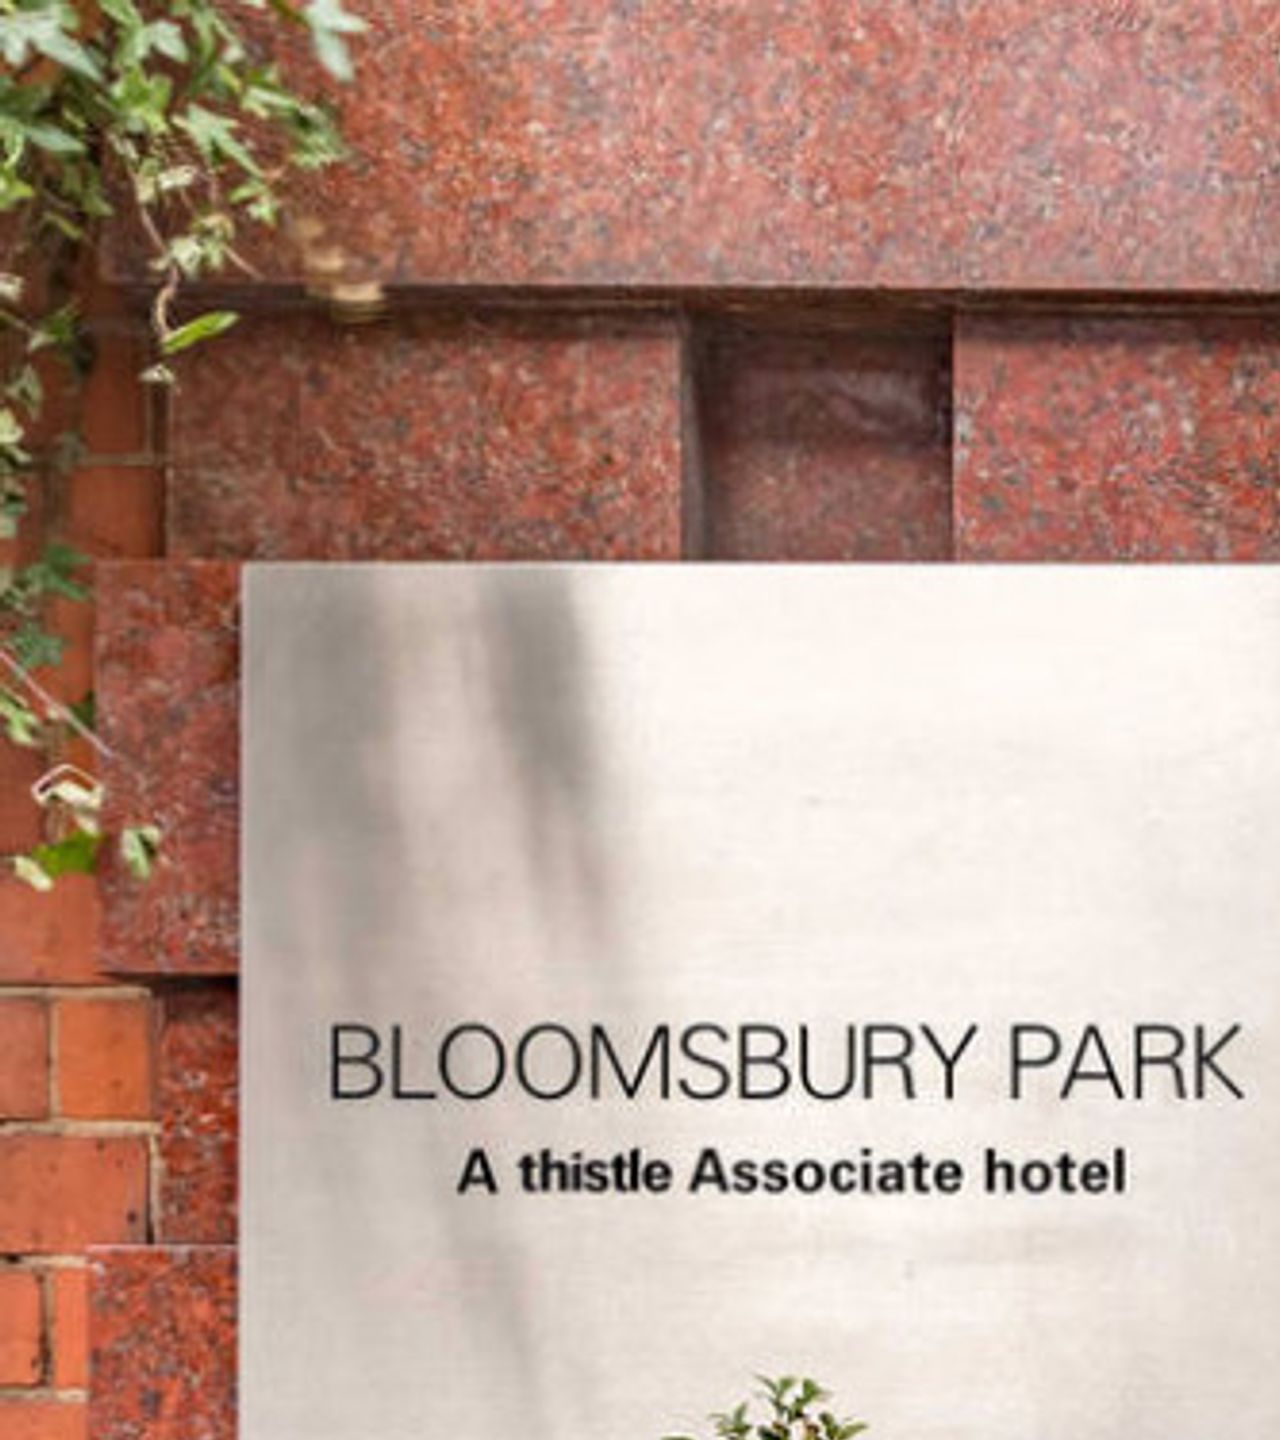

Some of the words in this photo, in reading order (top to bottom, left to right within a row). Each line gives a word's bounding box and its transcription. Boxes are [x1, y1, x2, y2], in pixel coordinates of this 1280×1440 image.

[330, 1022, 977, 1101] BLOOMSBURY
[1011, 1024, 1245, 1100] PARK
[457, 1148, 498, 1193] A
[517, 1148, 673, 1193] thistle
[689, 1148, 963, 1193] Associate
[985, 1147, 1126, 1193] hotel
